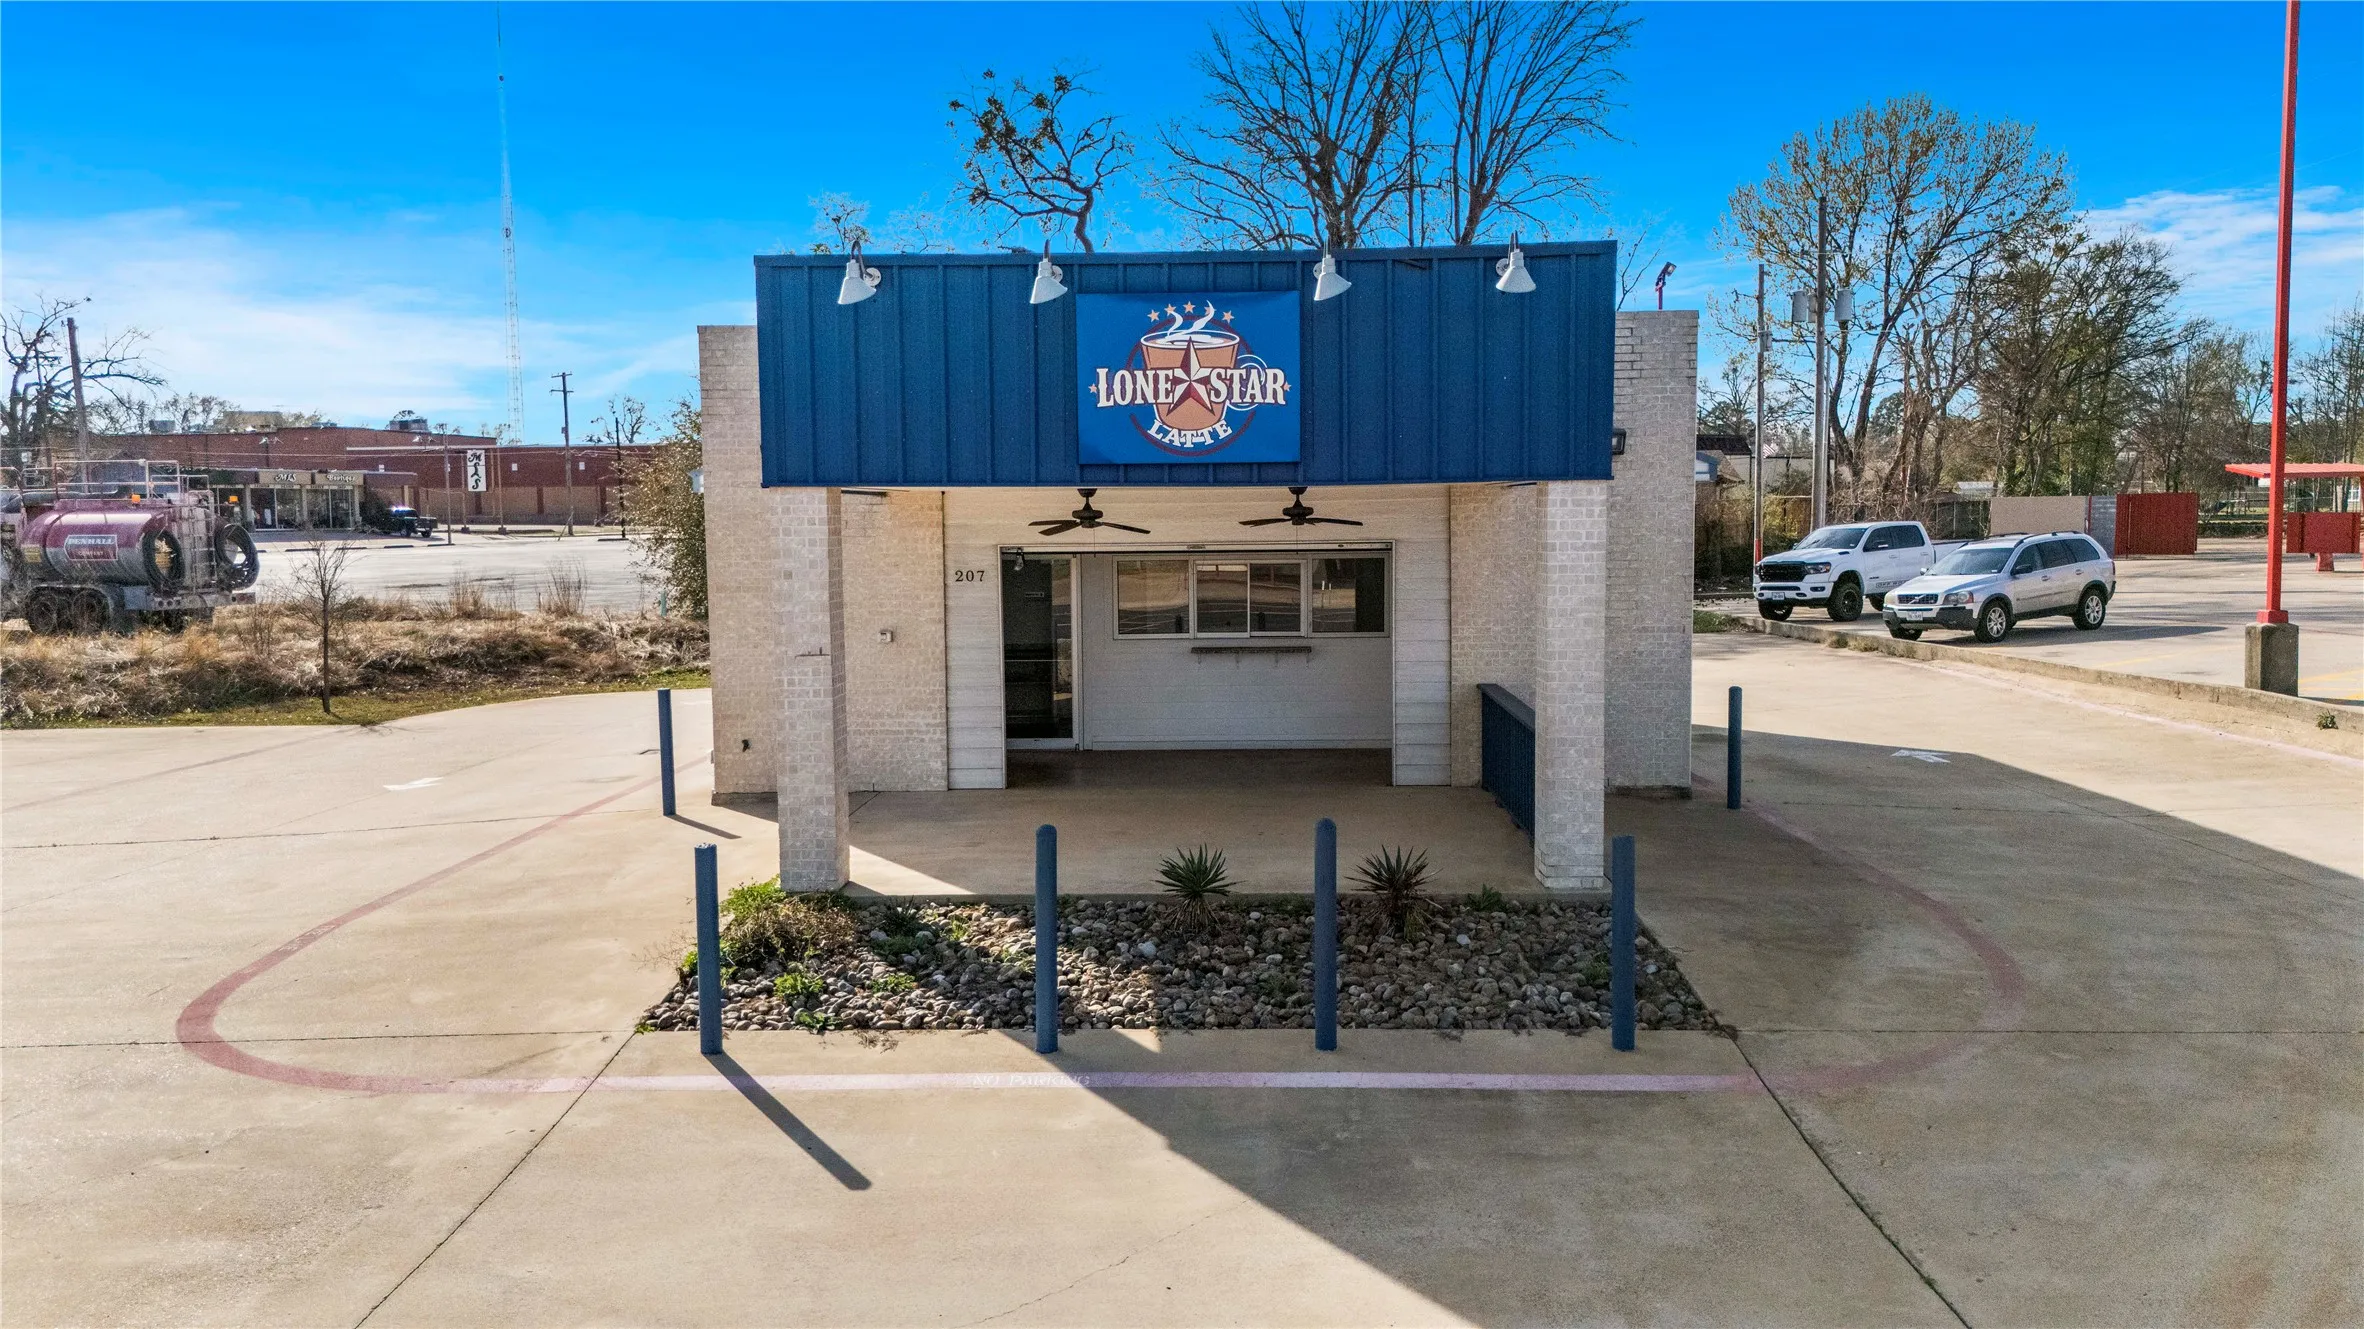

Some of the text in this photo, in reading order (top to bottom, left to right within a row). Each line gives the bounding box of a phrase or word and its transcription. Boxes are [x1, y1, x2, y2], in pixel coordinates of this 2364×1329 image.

[1096, 368, 1286, 408] LONE STAR
[1147, 419, 1233, 448] LATTE
[954, 569, 985, 582] 207
[972, 1073, 1091, 1087] NO PARKING
